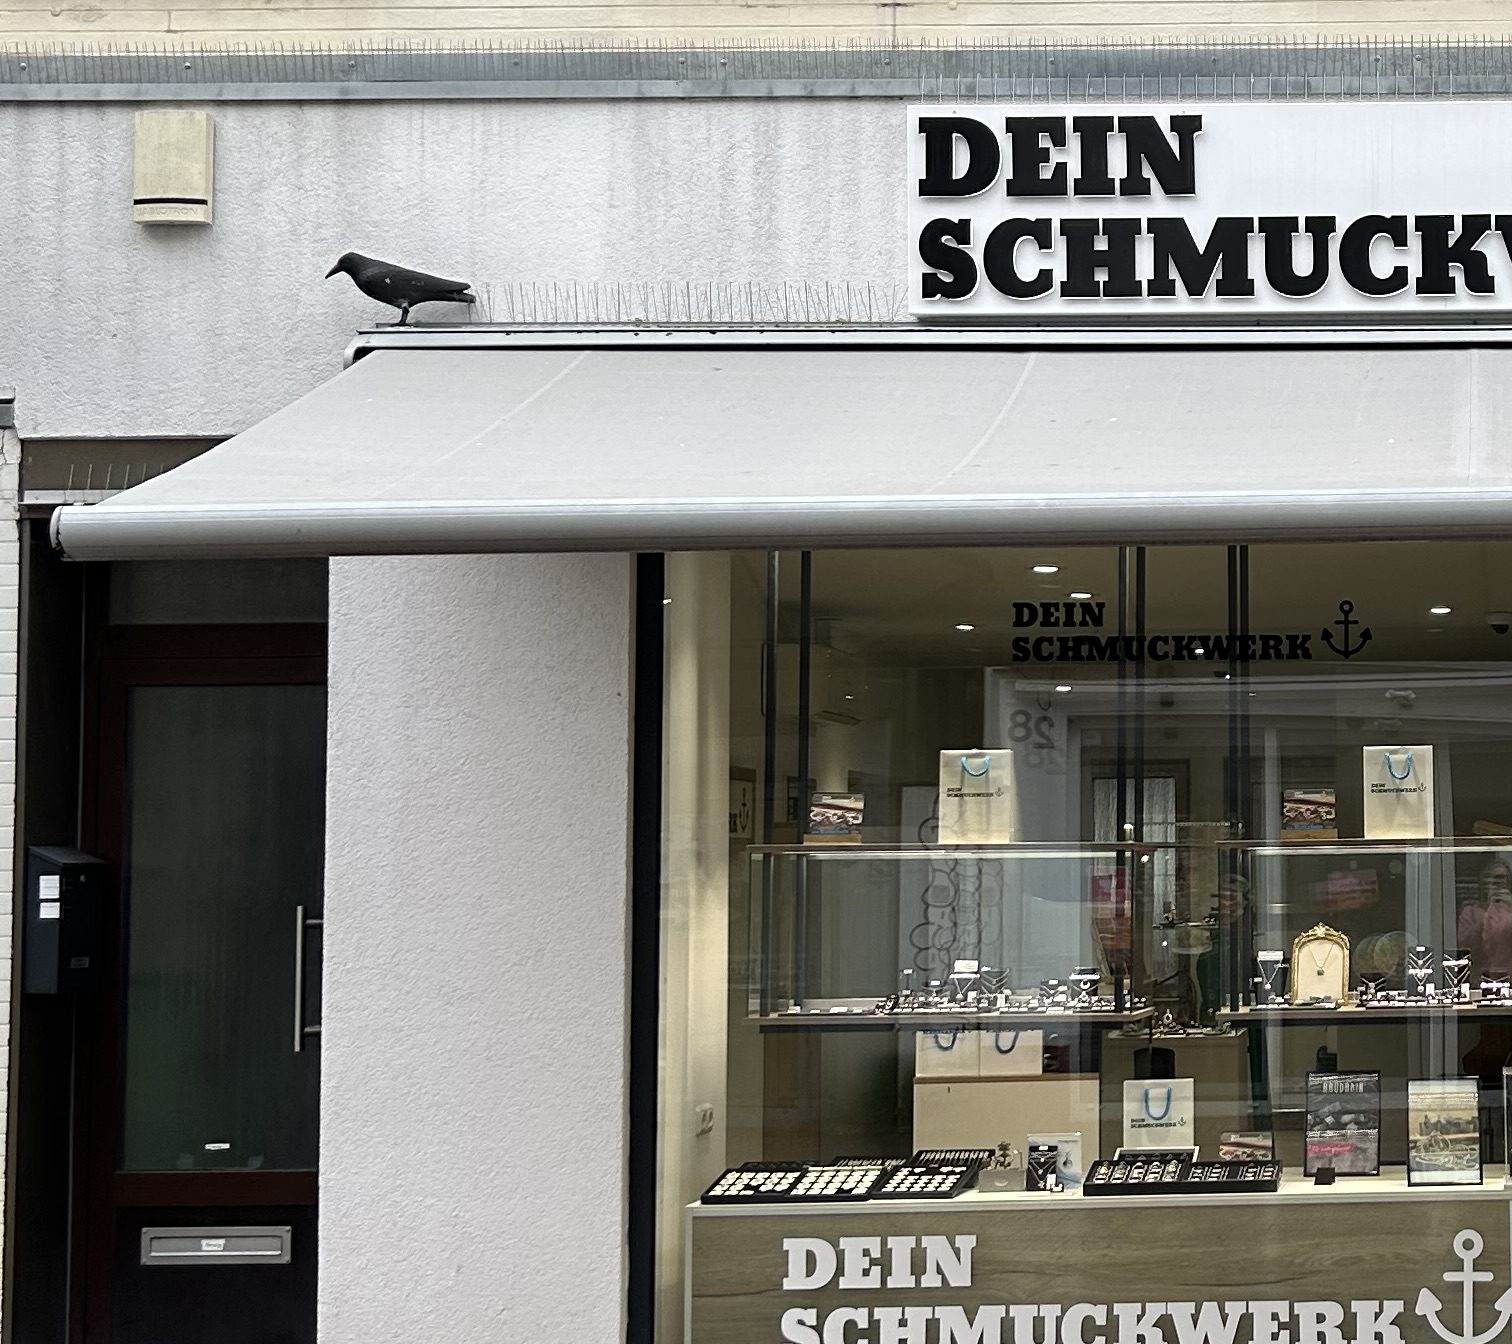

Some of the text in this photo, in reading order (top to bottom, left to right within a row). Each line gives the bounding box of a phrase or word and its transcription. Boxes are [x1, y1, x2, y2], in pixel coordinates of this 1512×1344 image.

[917, 114, 1203, 197] DEIN
[1012, 602, 1106, 628] DEIN
[1012, 634, 1313, 663] SCHMUCKWERK
[782, 1234, 977, 1290] DEIN
